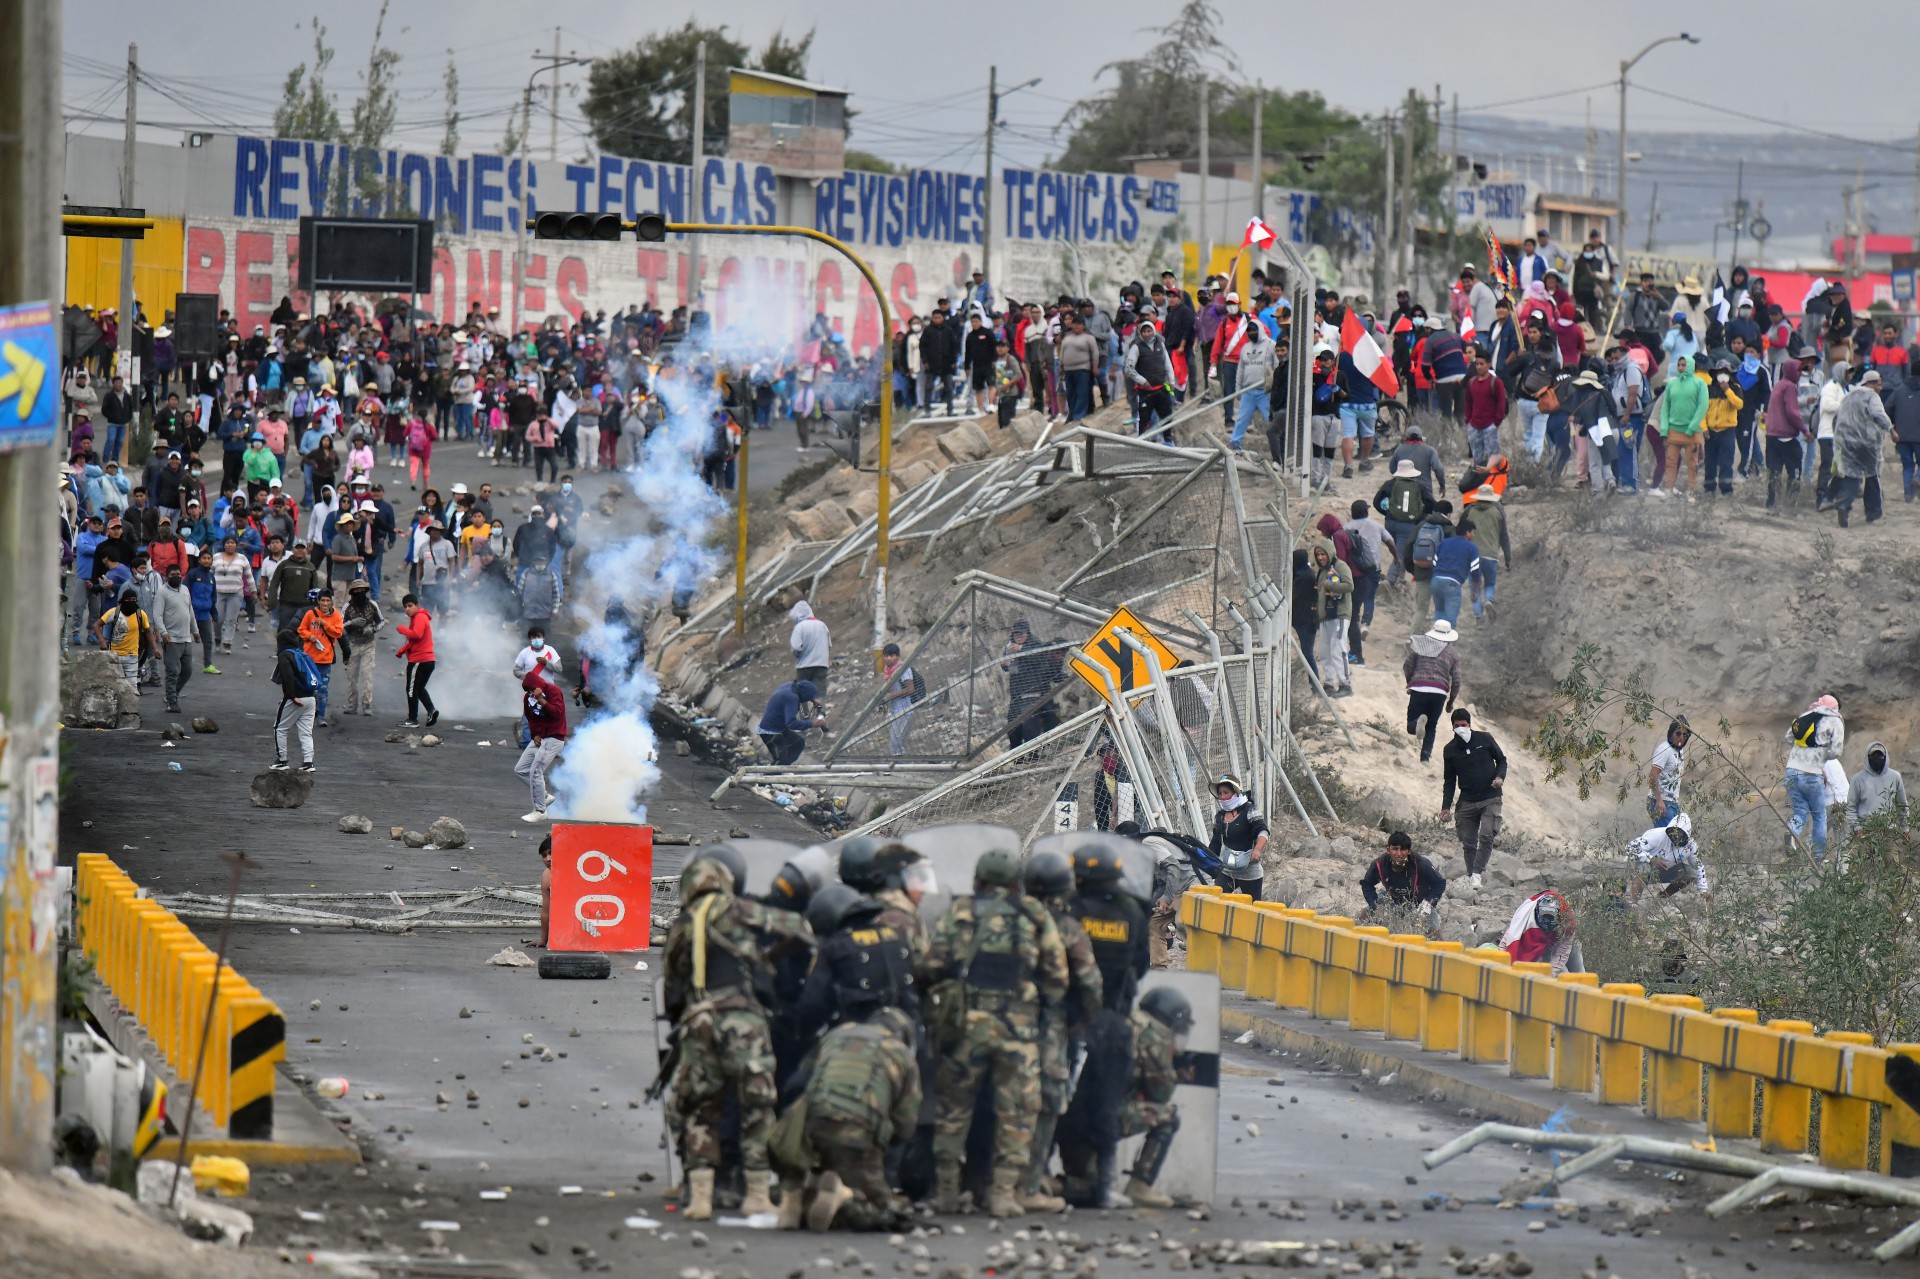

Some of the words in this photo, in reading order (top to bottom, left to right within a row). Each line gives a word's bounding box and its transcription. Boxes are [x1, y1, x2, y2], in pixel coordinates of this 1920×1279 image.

[233, 136, 538, 235] REVISIONES
[815, 169, 985, 247] REVISIONES
[1003, 168, 1140, 242] TECNICAS
[187, 227, 590, 345] REONES
[1084, 919, 1128, 940] POLICIA
